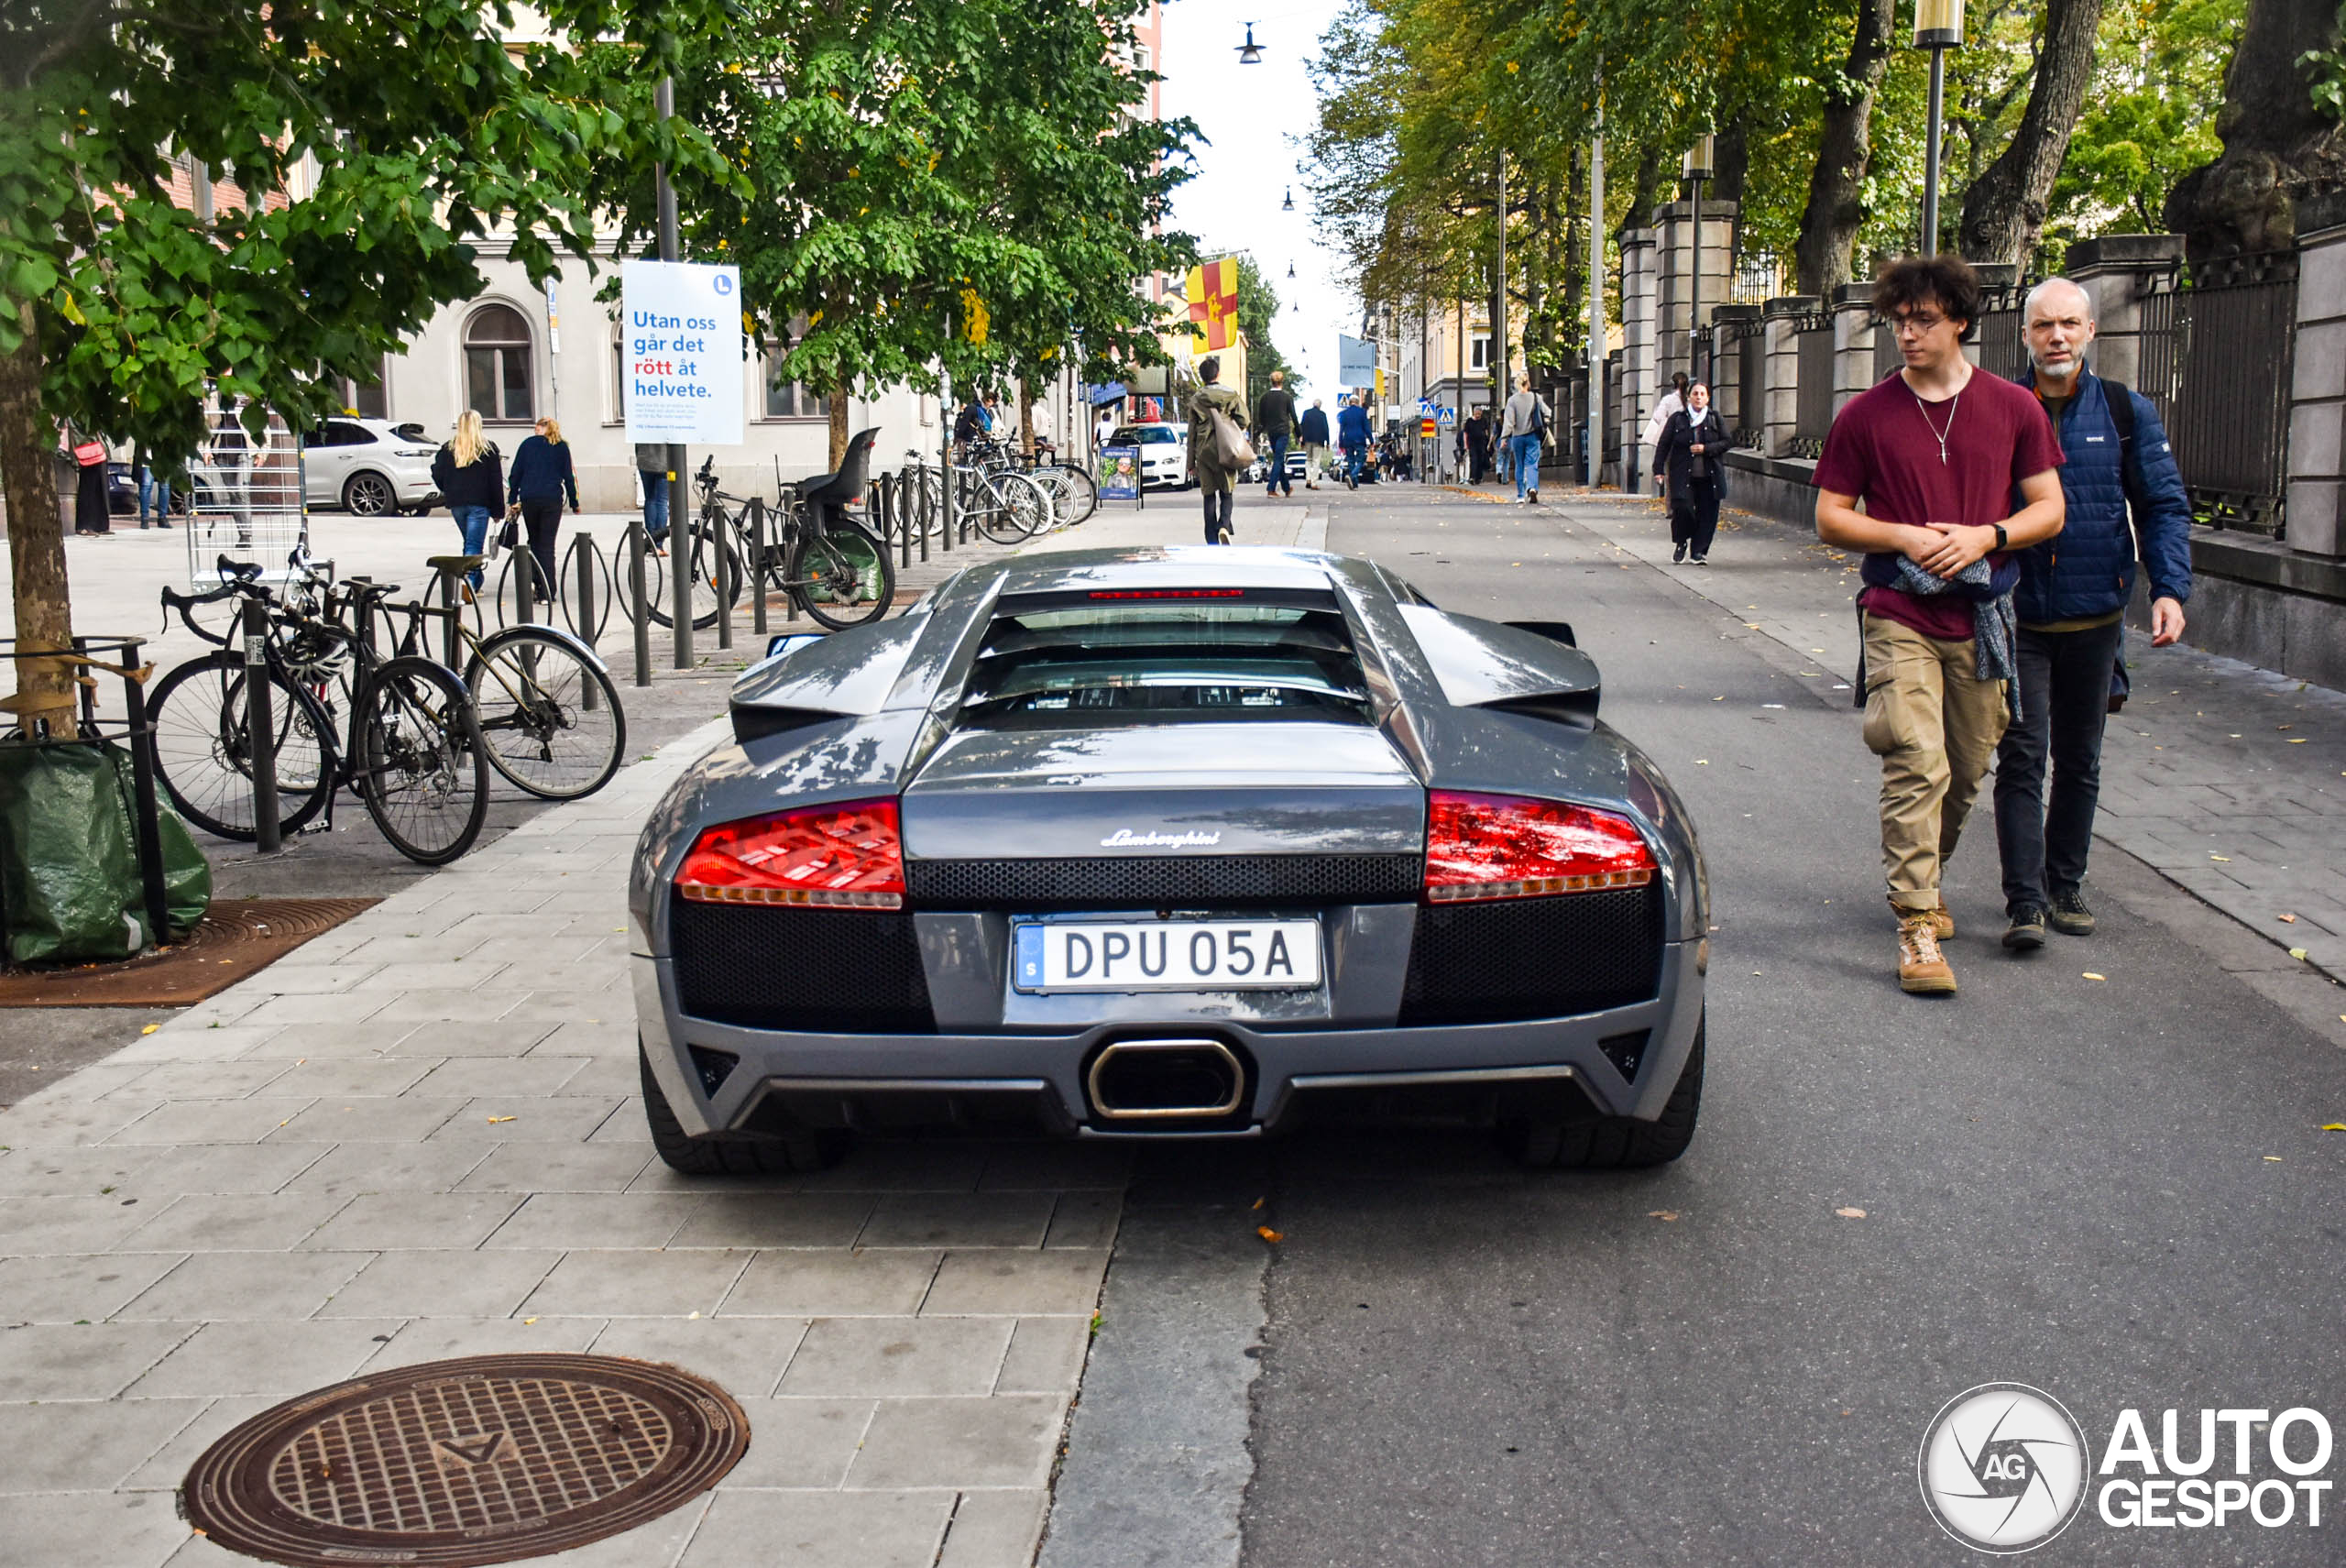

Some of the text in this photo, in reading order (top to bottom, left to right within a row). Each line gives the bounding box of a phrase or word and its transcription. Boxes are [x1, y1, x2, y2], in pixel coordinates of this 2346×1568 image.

[634, 311, 716, 330] Utan oss
[634, 333, 705, 355] går det
[635, 358, 696, 376] rött åt
[635, 379, 712, 398] helvete.
[1101, 828, 1221, 850] Lamborghini
[1066, 930, 1294, 978] DPU 05A
[1026, 962, 1036, 976] S
